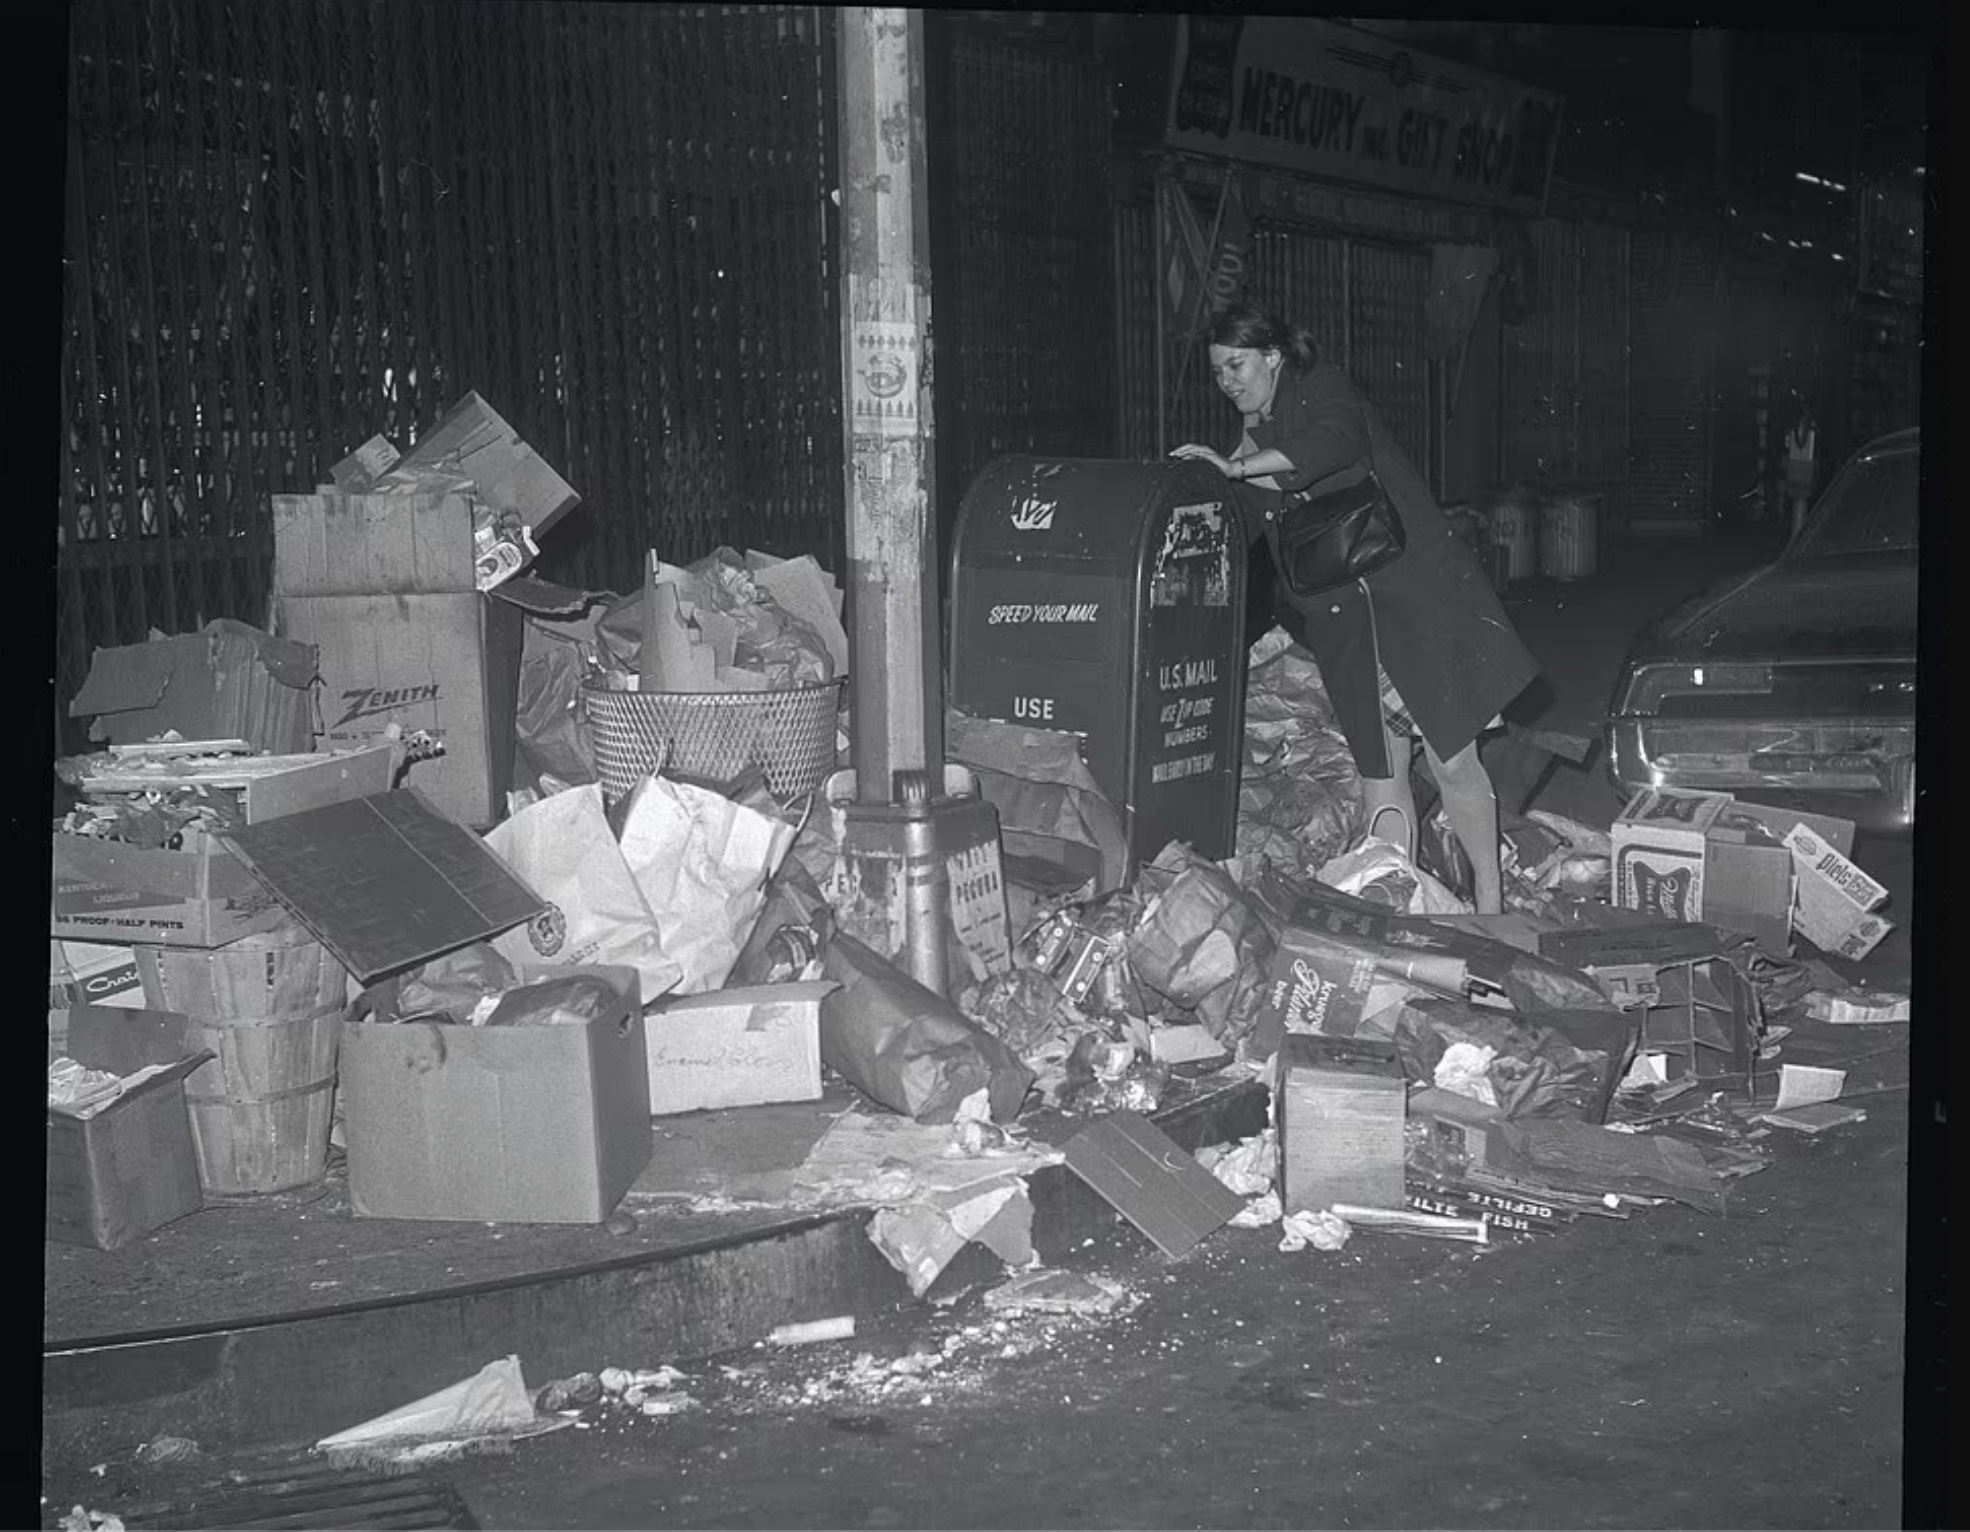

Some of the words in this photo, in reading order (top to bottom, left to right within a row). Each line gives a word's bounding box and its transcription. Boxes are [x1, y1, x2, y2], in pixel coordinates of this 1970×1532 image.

[1241, 65, 1366, 152] MERCURY
[988, 604, 1033, 624] SPEED
[1033, 604, 1067, 622] YOUR
[1066, 603, 1099, 622] MAIL
[1185, 659, 1218, 688] MAIL
[331, 684, 440, 729] ZENITH
[1014, 696, 1054, 720] USE
[149, 919, 184, 929] PINTS
[1467, 1191, 1552, 1218] GEFILTE
[1482, 1211, 1529, 1230] FISH
